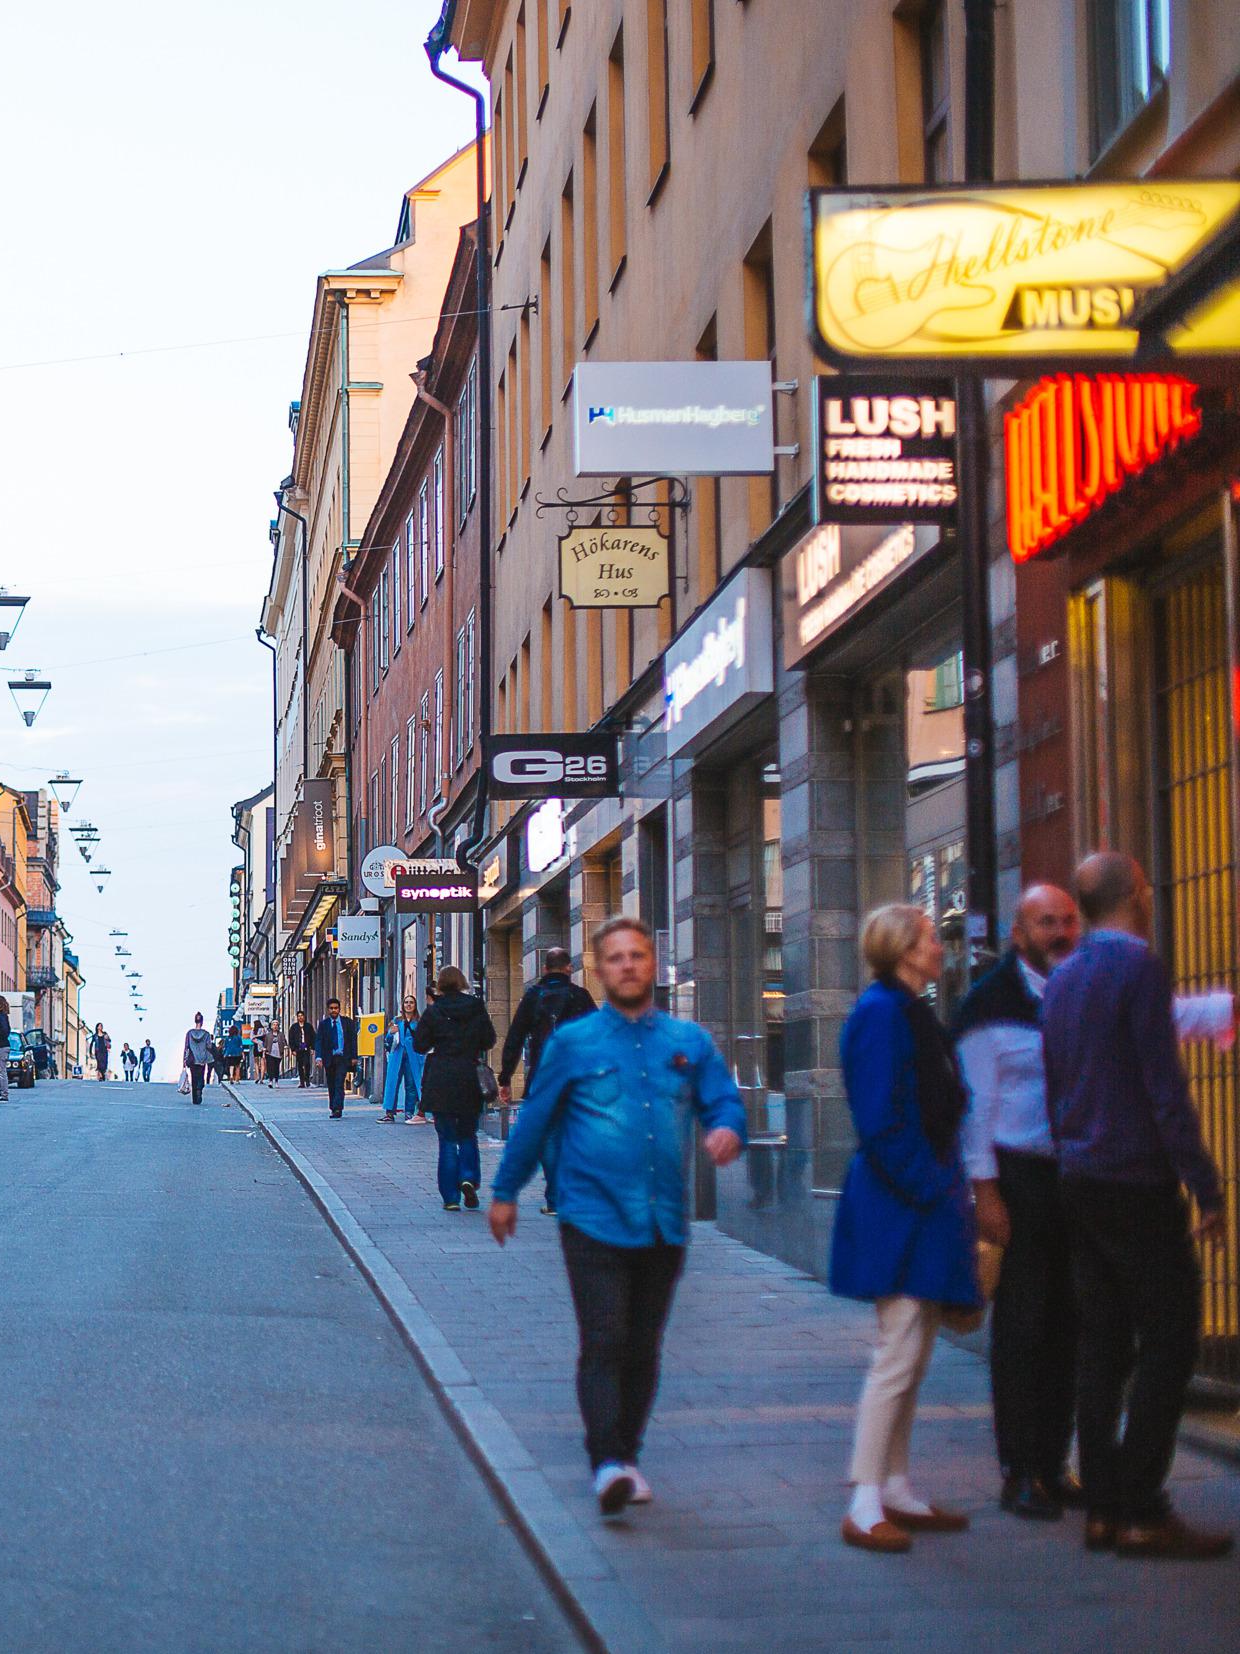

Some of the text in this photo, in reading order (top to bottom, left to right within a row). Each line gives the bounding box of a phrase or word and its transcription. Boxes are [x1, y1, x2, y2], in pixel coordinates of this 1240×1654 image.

[1023, 288, 1135, 327] MUSI
[826, 397, 957, 437] LUSH
[827, 460, 954, 480] HANDMADE
[828, 482, 957, 505] COSMETICS
[571, 532, 660, 563] Hökarens
[598, 563, 634, 580] Hus
[401, 887, 473, 900] synoptik
[341, 931, 377, 944] Sandys
